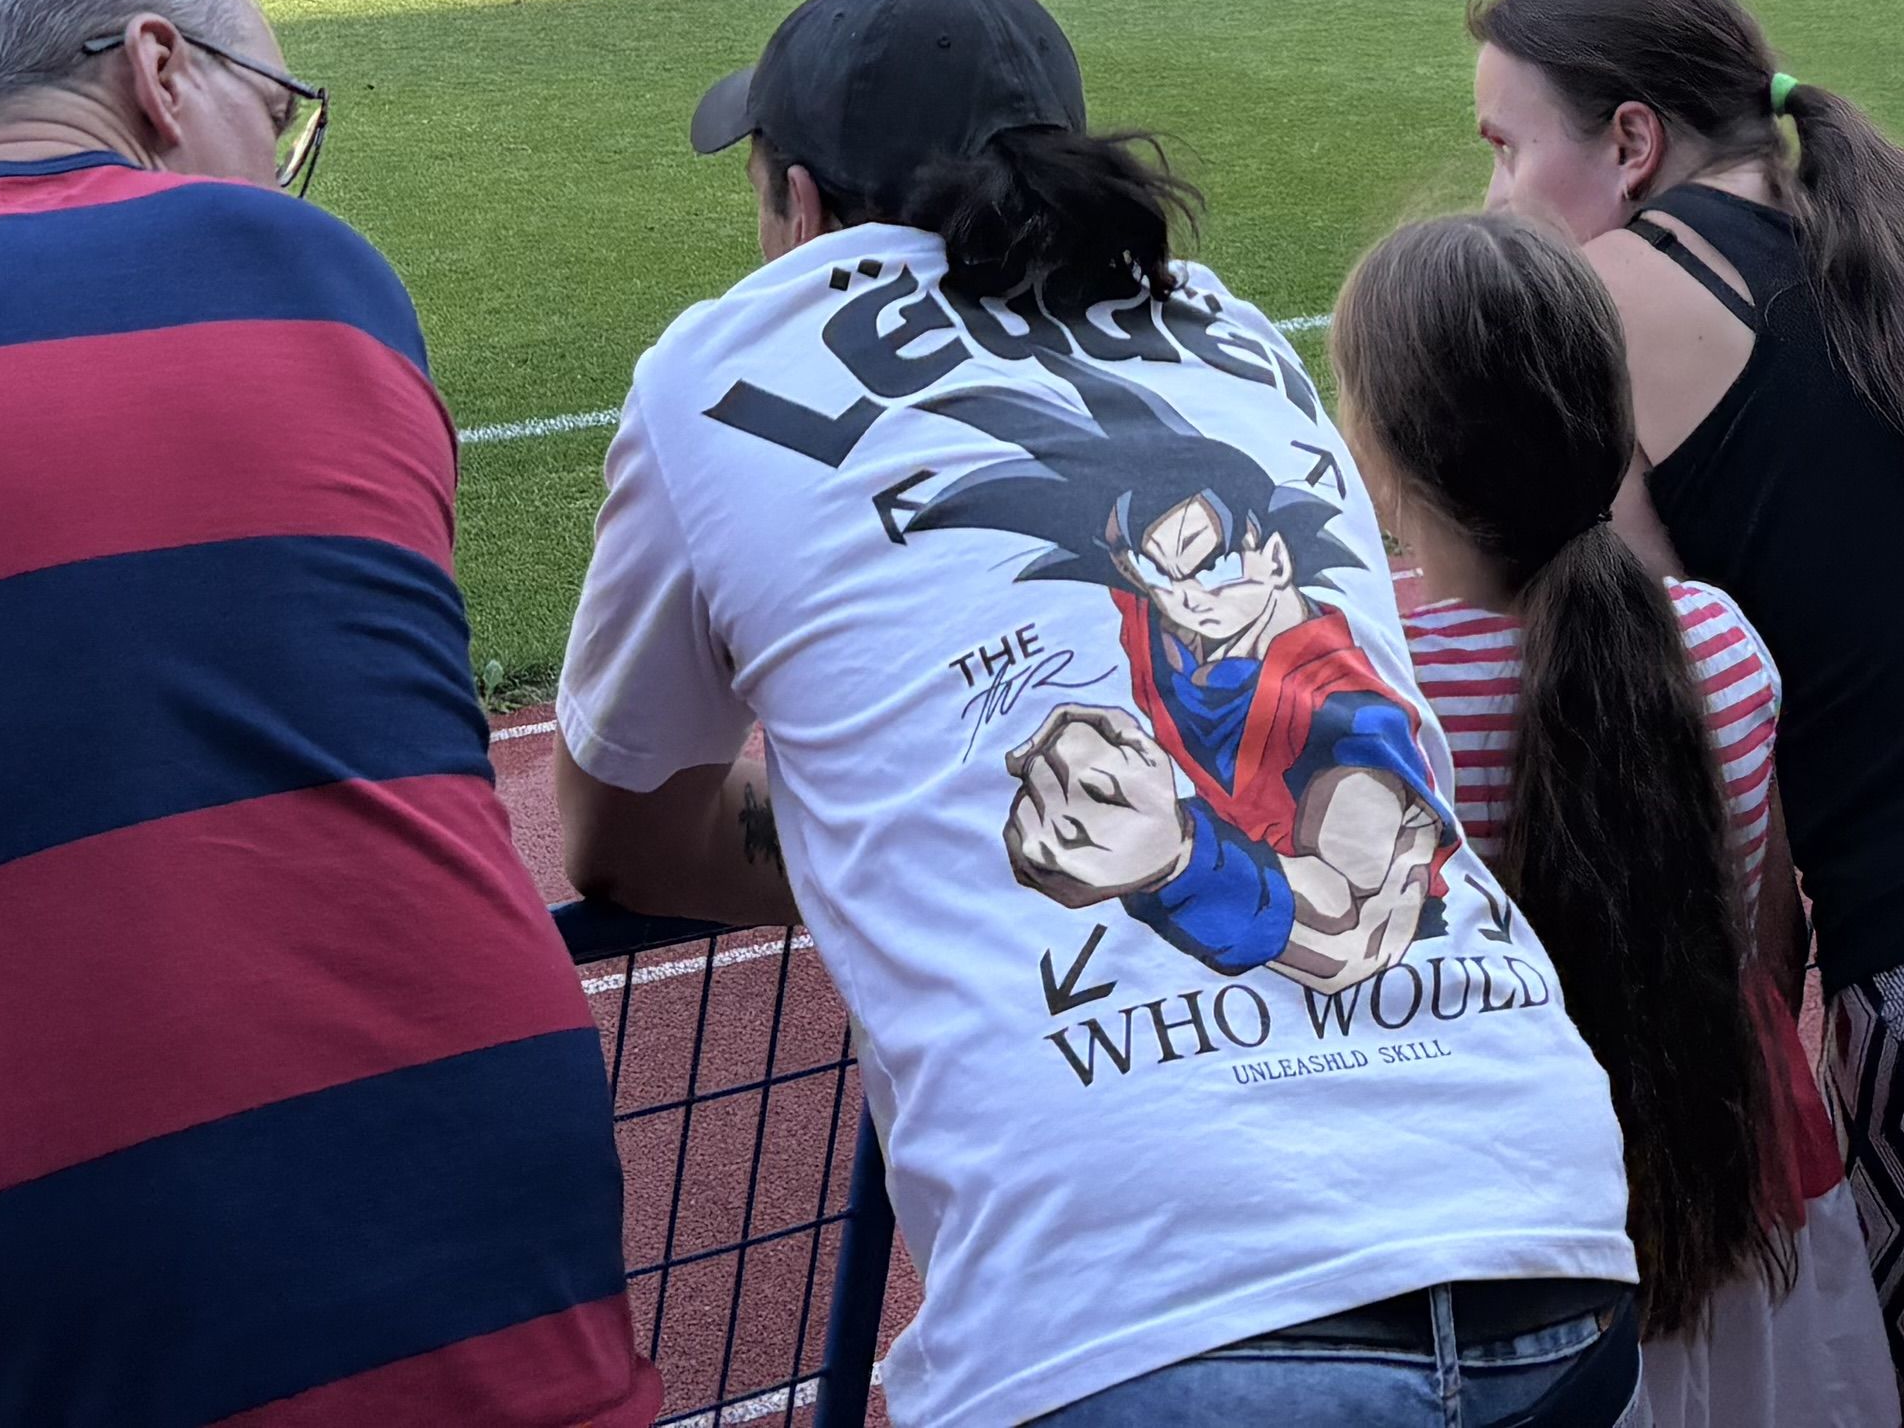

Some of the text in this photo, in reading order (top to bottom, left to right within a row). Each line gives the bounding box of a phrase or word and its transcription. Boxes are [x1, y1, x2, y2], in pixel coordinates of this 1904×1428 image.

[948, 622, 1045, 688] THE
[1043, 955, 1550, 1088] WHO WOULD
[1380, 1039, 1452, 1066] SKILL
